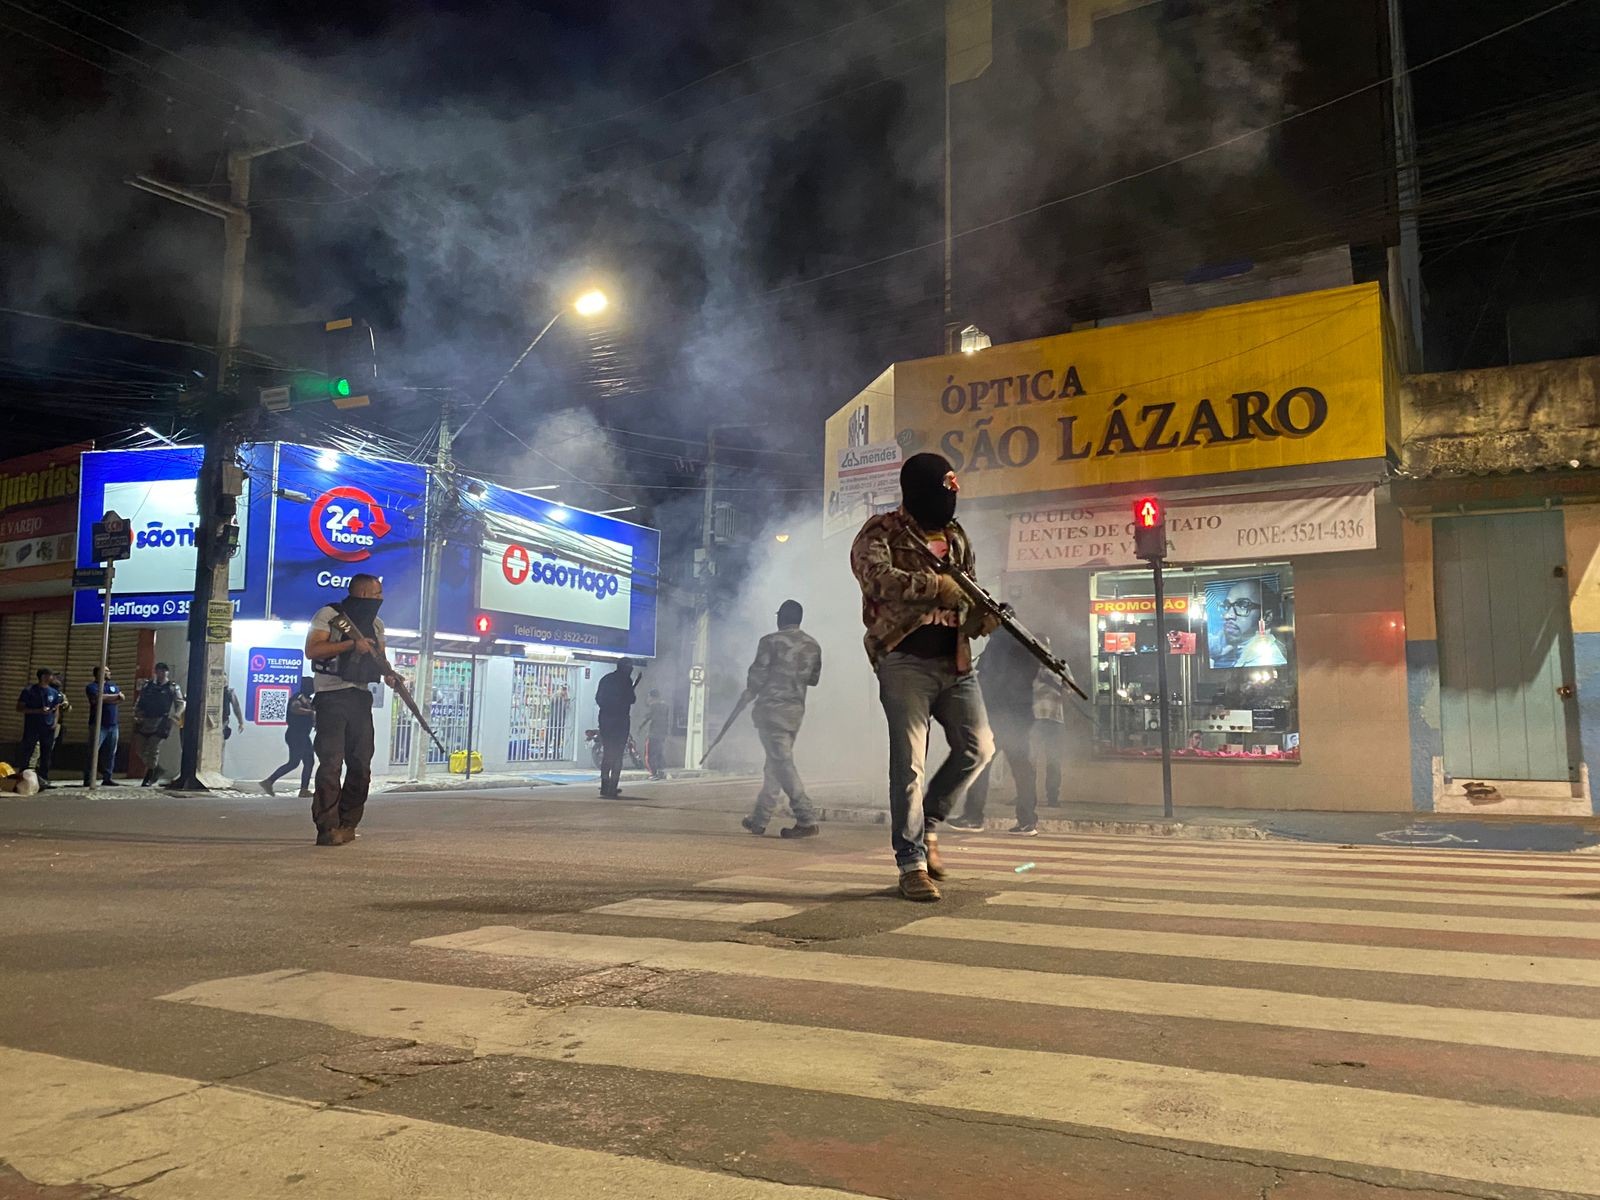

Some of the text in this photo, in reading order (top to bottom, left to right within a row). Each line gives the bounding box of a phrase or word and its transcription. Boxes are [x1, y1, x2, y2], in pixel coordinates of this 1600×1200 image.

[940, 365, 1086, 414] ÓPTICA
[939, 386, 1329, 474] SÃO LÁZARO
[8, 516, 42, 534] VAREJO
[326, 505, 363, 531] 24
[1018, 514, 1222, 543] LENTES DE CTATO
[136, 521, 196, 549] sãoTi
[331, 529, 374, 546] horas
[1237, 518, 1365, 546] FONE: 3521-4336
[1017, 545, 1082, 561] EXAME
[1088, 543, 1113, 557] DE
[100, 601, 160, 618] TeleTiago
[513, 624, 599, 645] TeleTiago 3522-2211
[267, 658, 302, 666] TELETIAGO
[252, 674, 298, 684] 3522-2211
